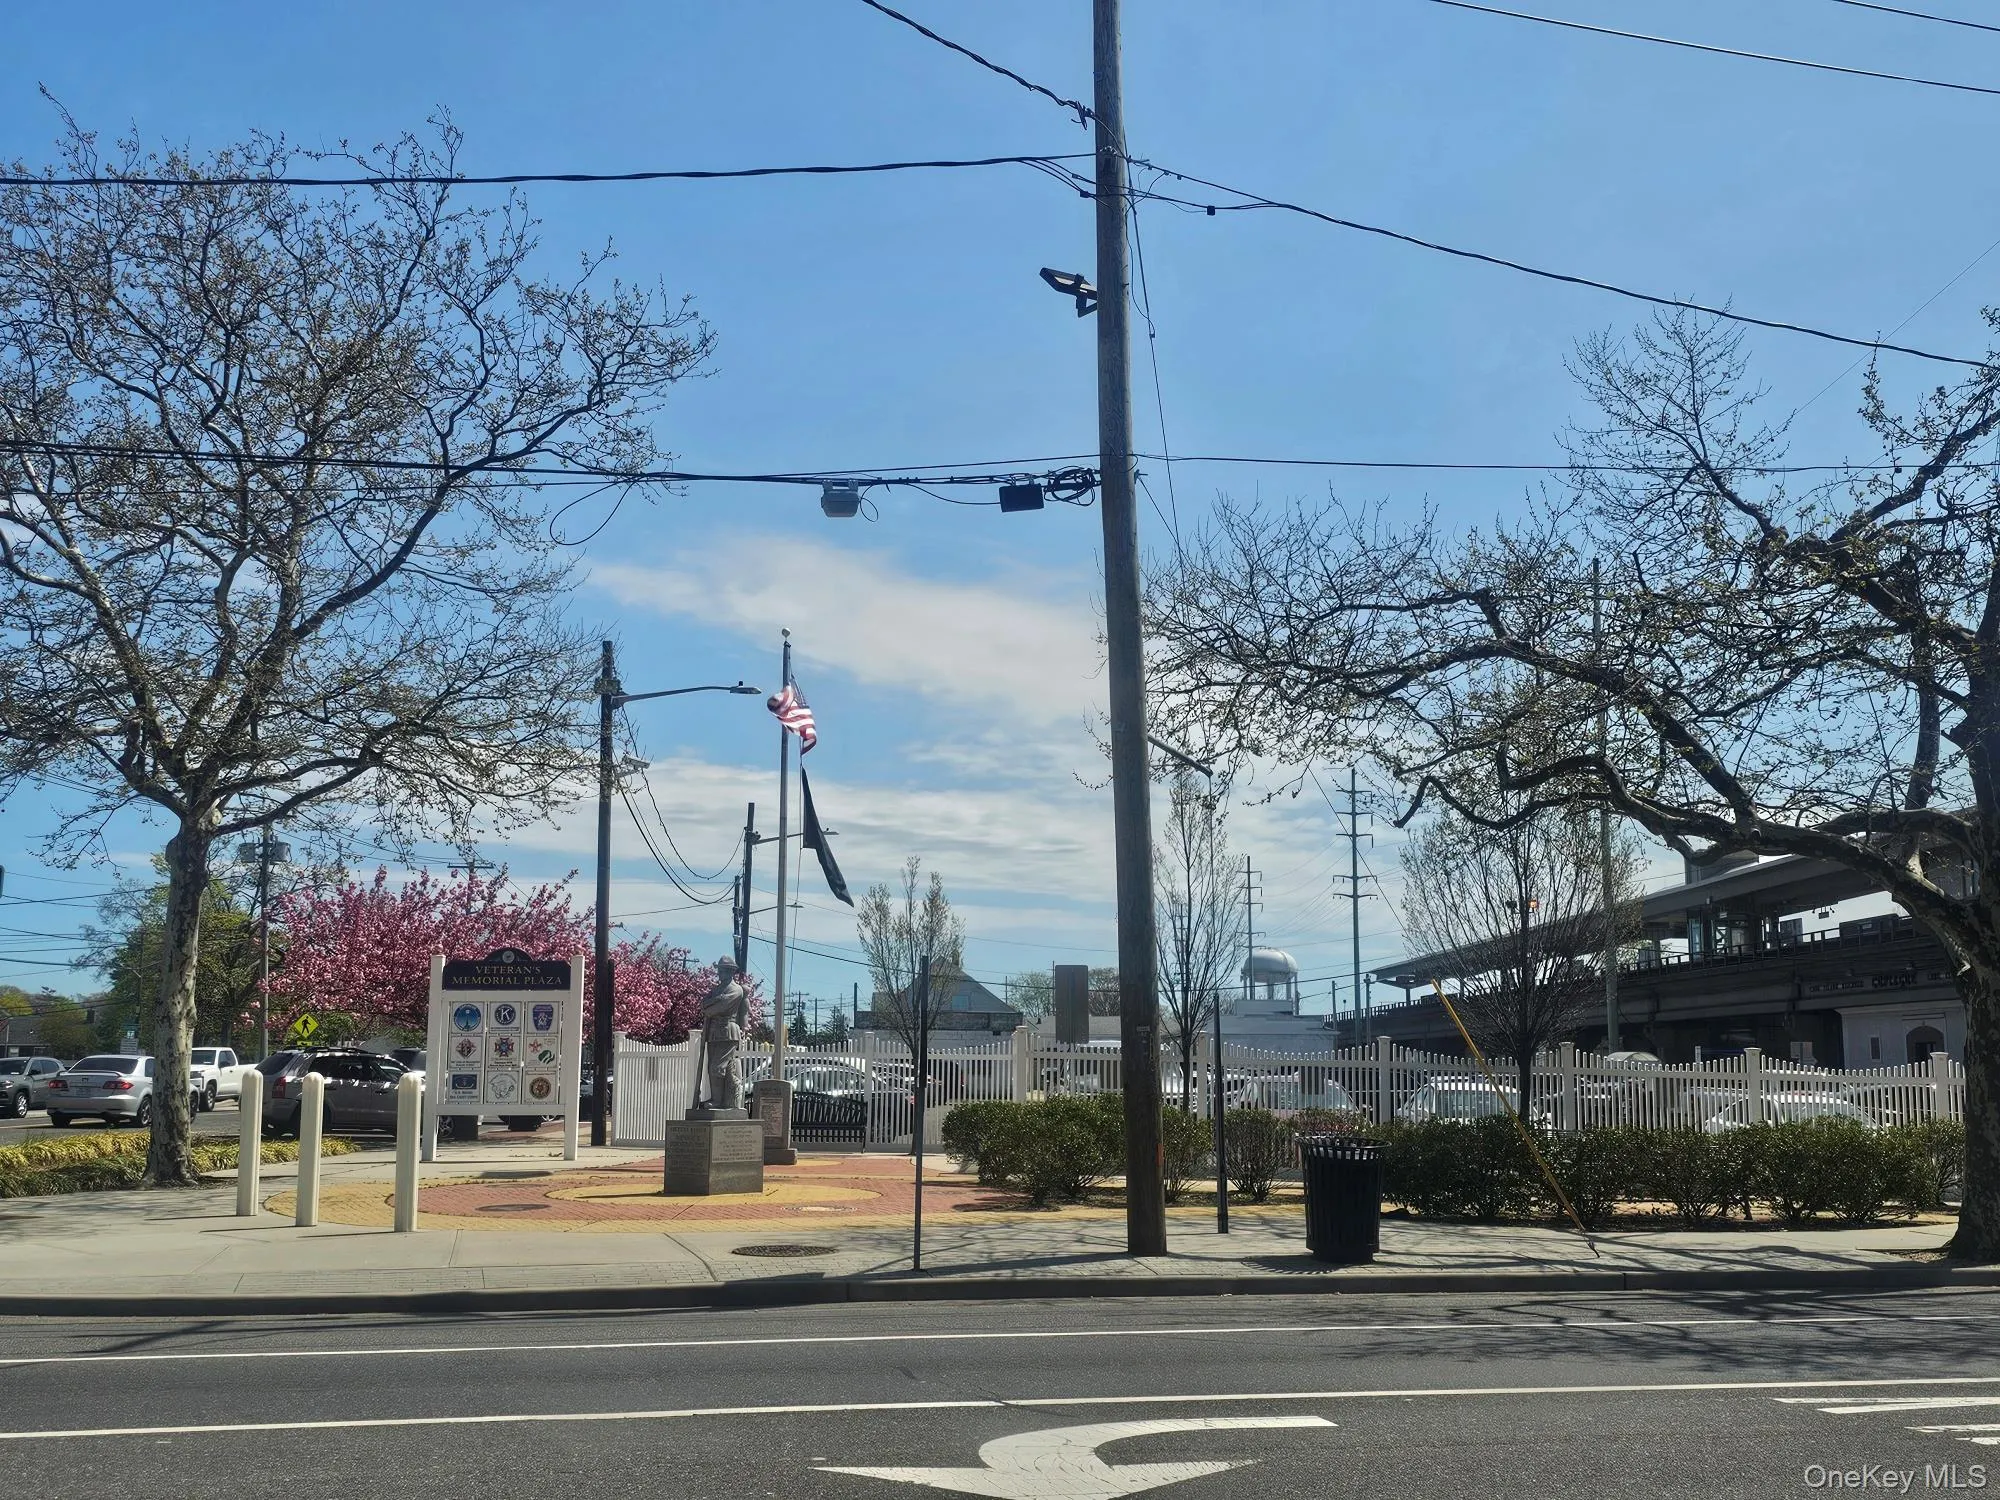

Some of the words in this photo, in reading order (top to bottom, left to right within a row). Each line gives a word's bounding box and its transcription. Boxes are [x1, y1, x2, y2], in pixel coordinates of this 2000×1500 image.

[475, 966, 541, 974] VETERAN'S
[451, 976, 520, 985] MEMORIAL
[524, 976, 562, 985] PLAZA
